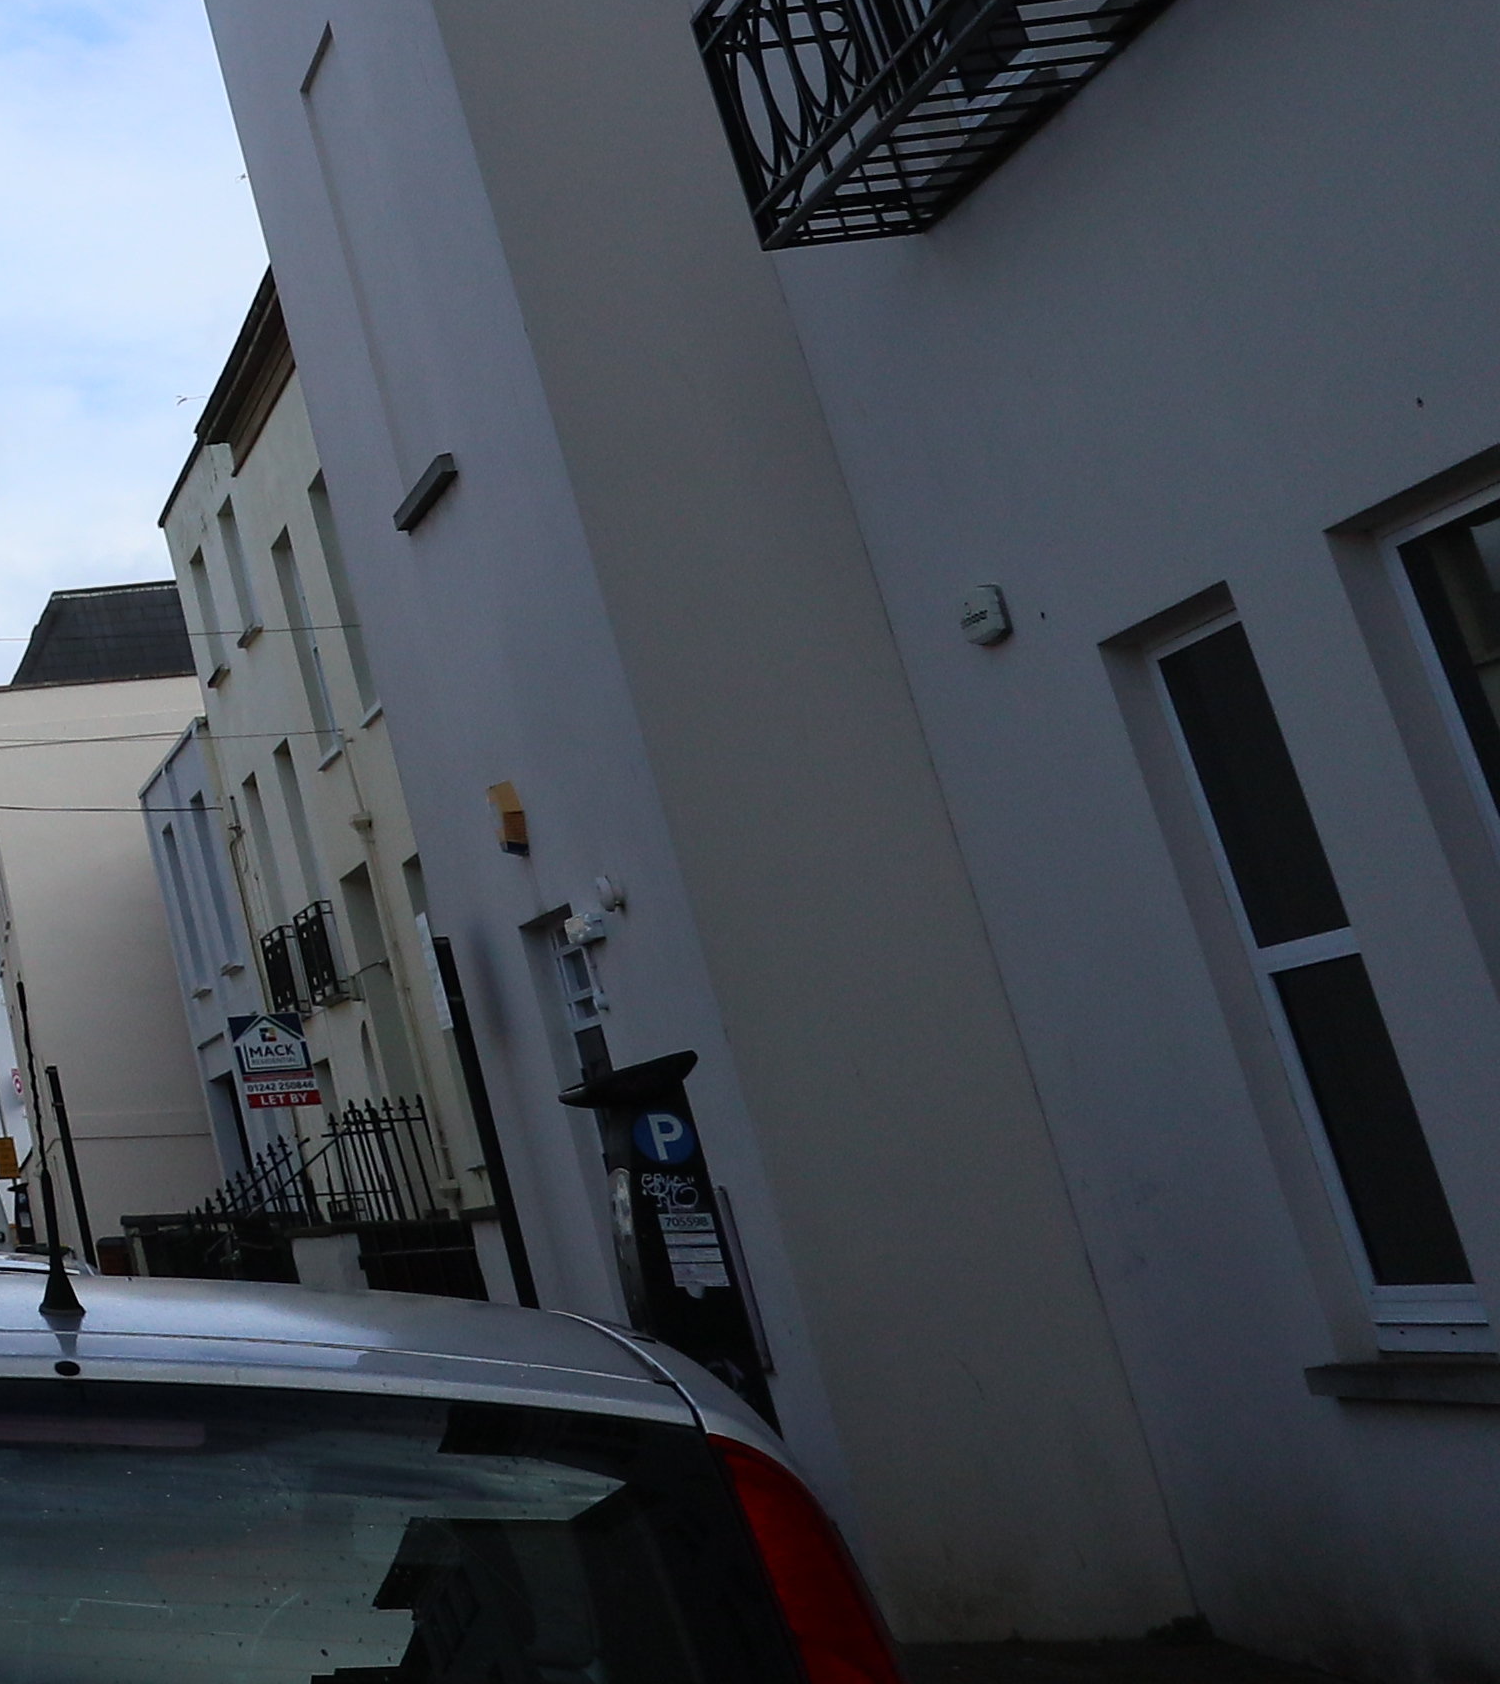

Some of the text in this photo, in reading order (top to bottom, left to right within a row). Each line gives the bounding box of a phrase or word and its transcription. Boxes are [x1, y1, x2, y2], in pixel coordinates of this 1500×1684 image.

[249, 1044, 296, 1058] MACK
[260, 1092, 308, 1105] LET BY
